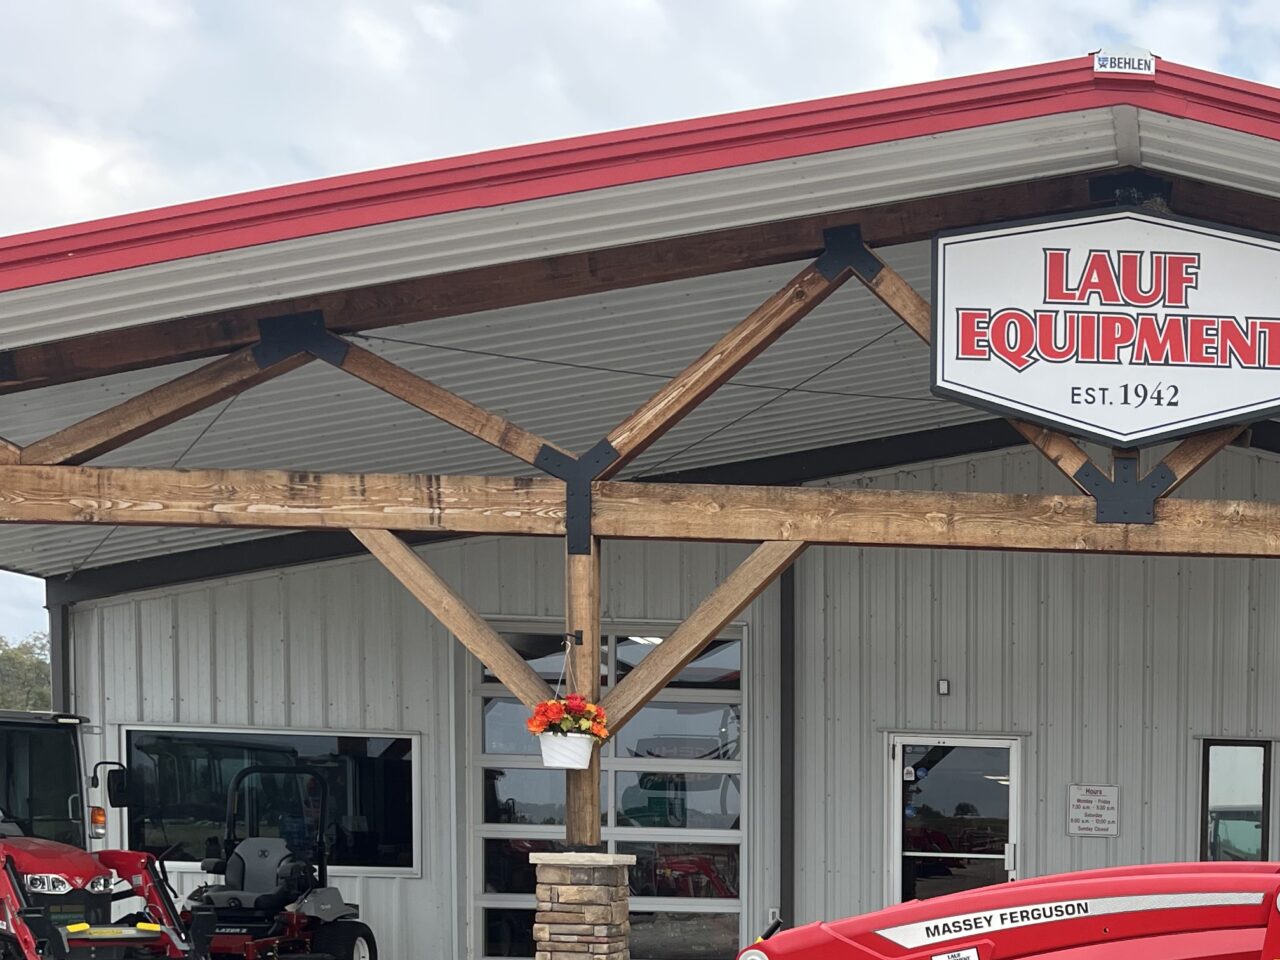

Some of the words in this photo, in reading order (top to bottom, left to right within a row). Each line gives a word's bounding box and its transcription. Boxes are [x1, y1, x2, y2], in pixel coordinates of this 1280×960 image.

[1110, 57, 1151, 71] BEHLEN
[1043, 248, 1200, 308] LAUF
[1071, 387, 1113, 405] EST.
[1120, 382, 1179, 407] 1942
[925, 915, 993, 938] MASSEY
[1000, 902, 1089, 925] FERGUSON
